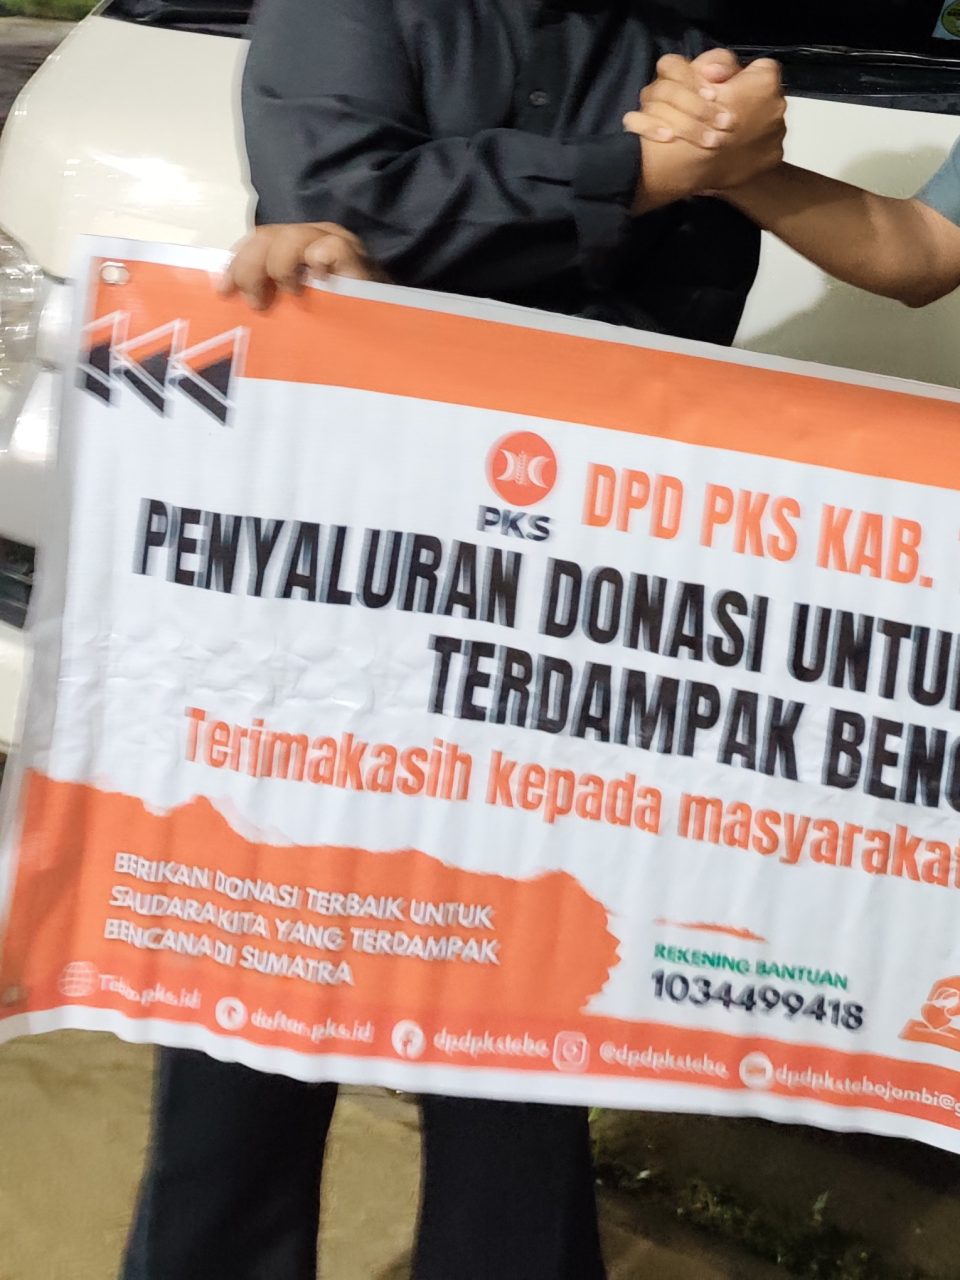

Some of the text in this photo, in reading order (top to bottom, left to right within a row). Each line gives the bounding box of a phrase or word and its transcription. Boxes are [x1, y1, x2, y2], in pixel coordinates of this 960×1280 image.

[475, 503, 555, 542] PKS
[581, 462, 684, 540] DPD
[700, 482, 801, 562] PKS
[816, 503, 935, 589] KAB.
[132, 497, 524, 629] PENYALURAN
[537, 556, 770, 673] DONASI
[427, 633, 806, 782] TERDAMPAK
[184, 705, 474, 801] Terimakasih
[484, 748, 665, 836] kepada
[114, 852, 496, 930] BERIKAN DONASI TERBAIK UNTUK
[240, 945, 355, 986] SUMATRA
[274, 918, 346, 952] YANG
[350, 927, 501, 965] TERDAMPAK
[653, 943, 850, 991] REKENING BANTUAN
[652, 968, 864, 1030] 1034499418
